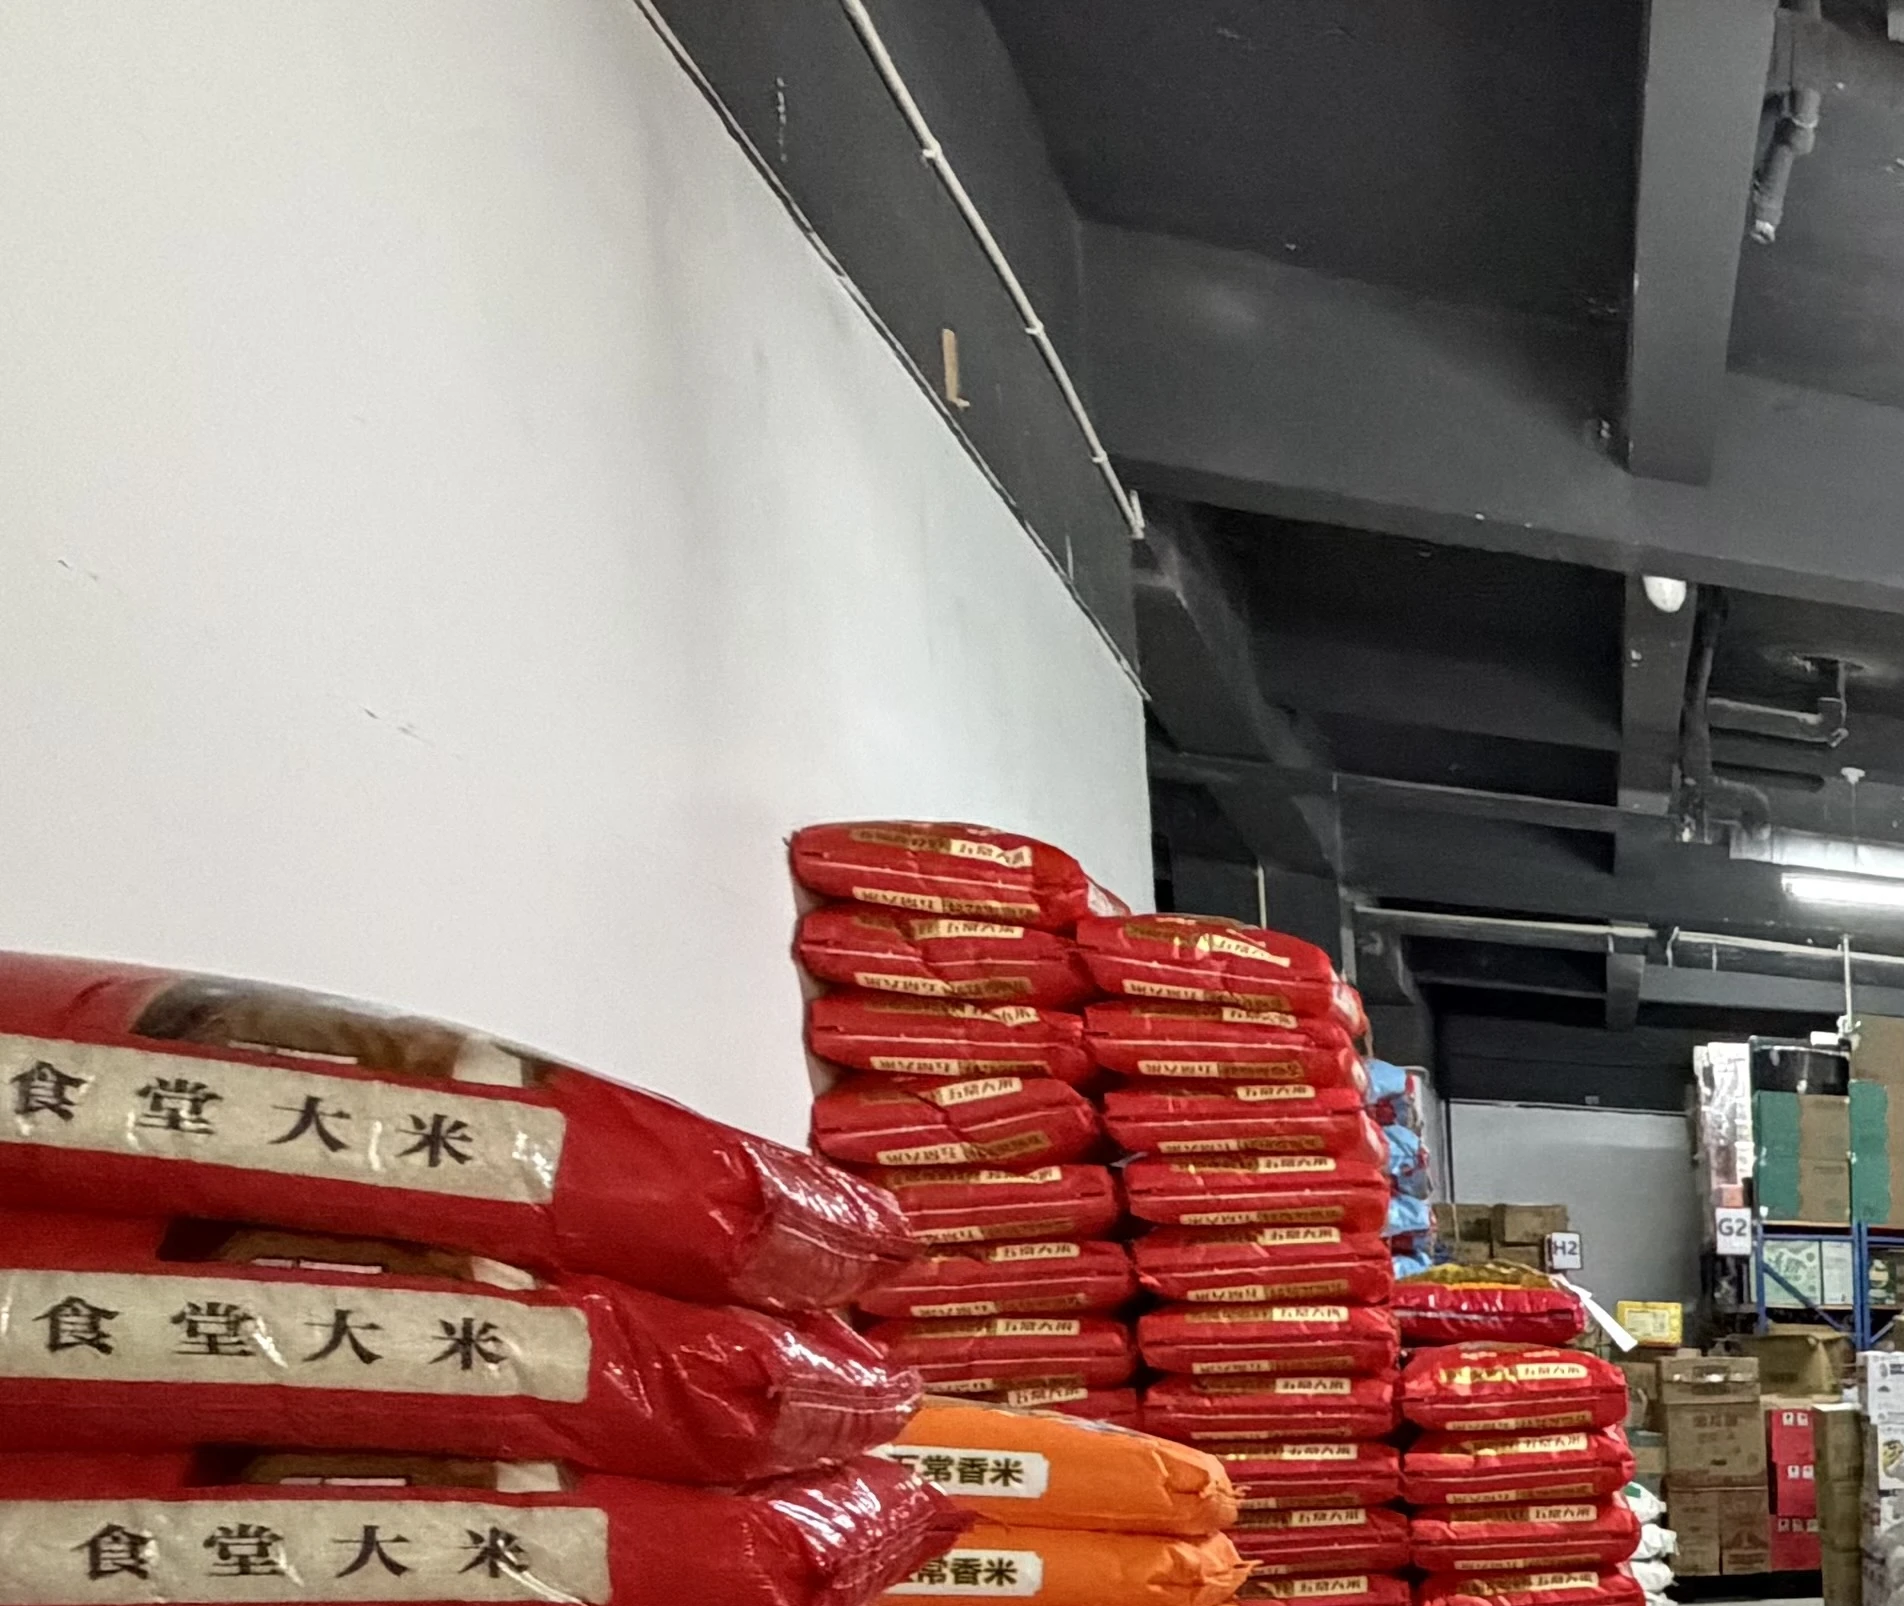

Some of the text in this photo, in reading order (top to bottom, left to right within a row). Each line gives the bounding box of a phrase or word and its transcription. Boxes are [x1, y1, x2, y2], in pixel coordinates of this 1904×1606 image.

[9, 1061, 475, 1168] 食堂大米
[1552, 1240, 1578, 1257] H2
[1718, 1217, 1748, 1237] G2
[34, 1295, 508, 1370] 食堂大米
[78, 1523, 531, 1582] 食堂大米
[905, 1557, 1018, 1587] 常香米
